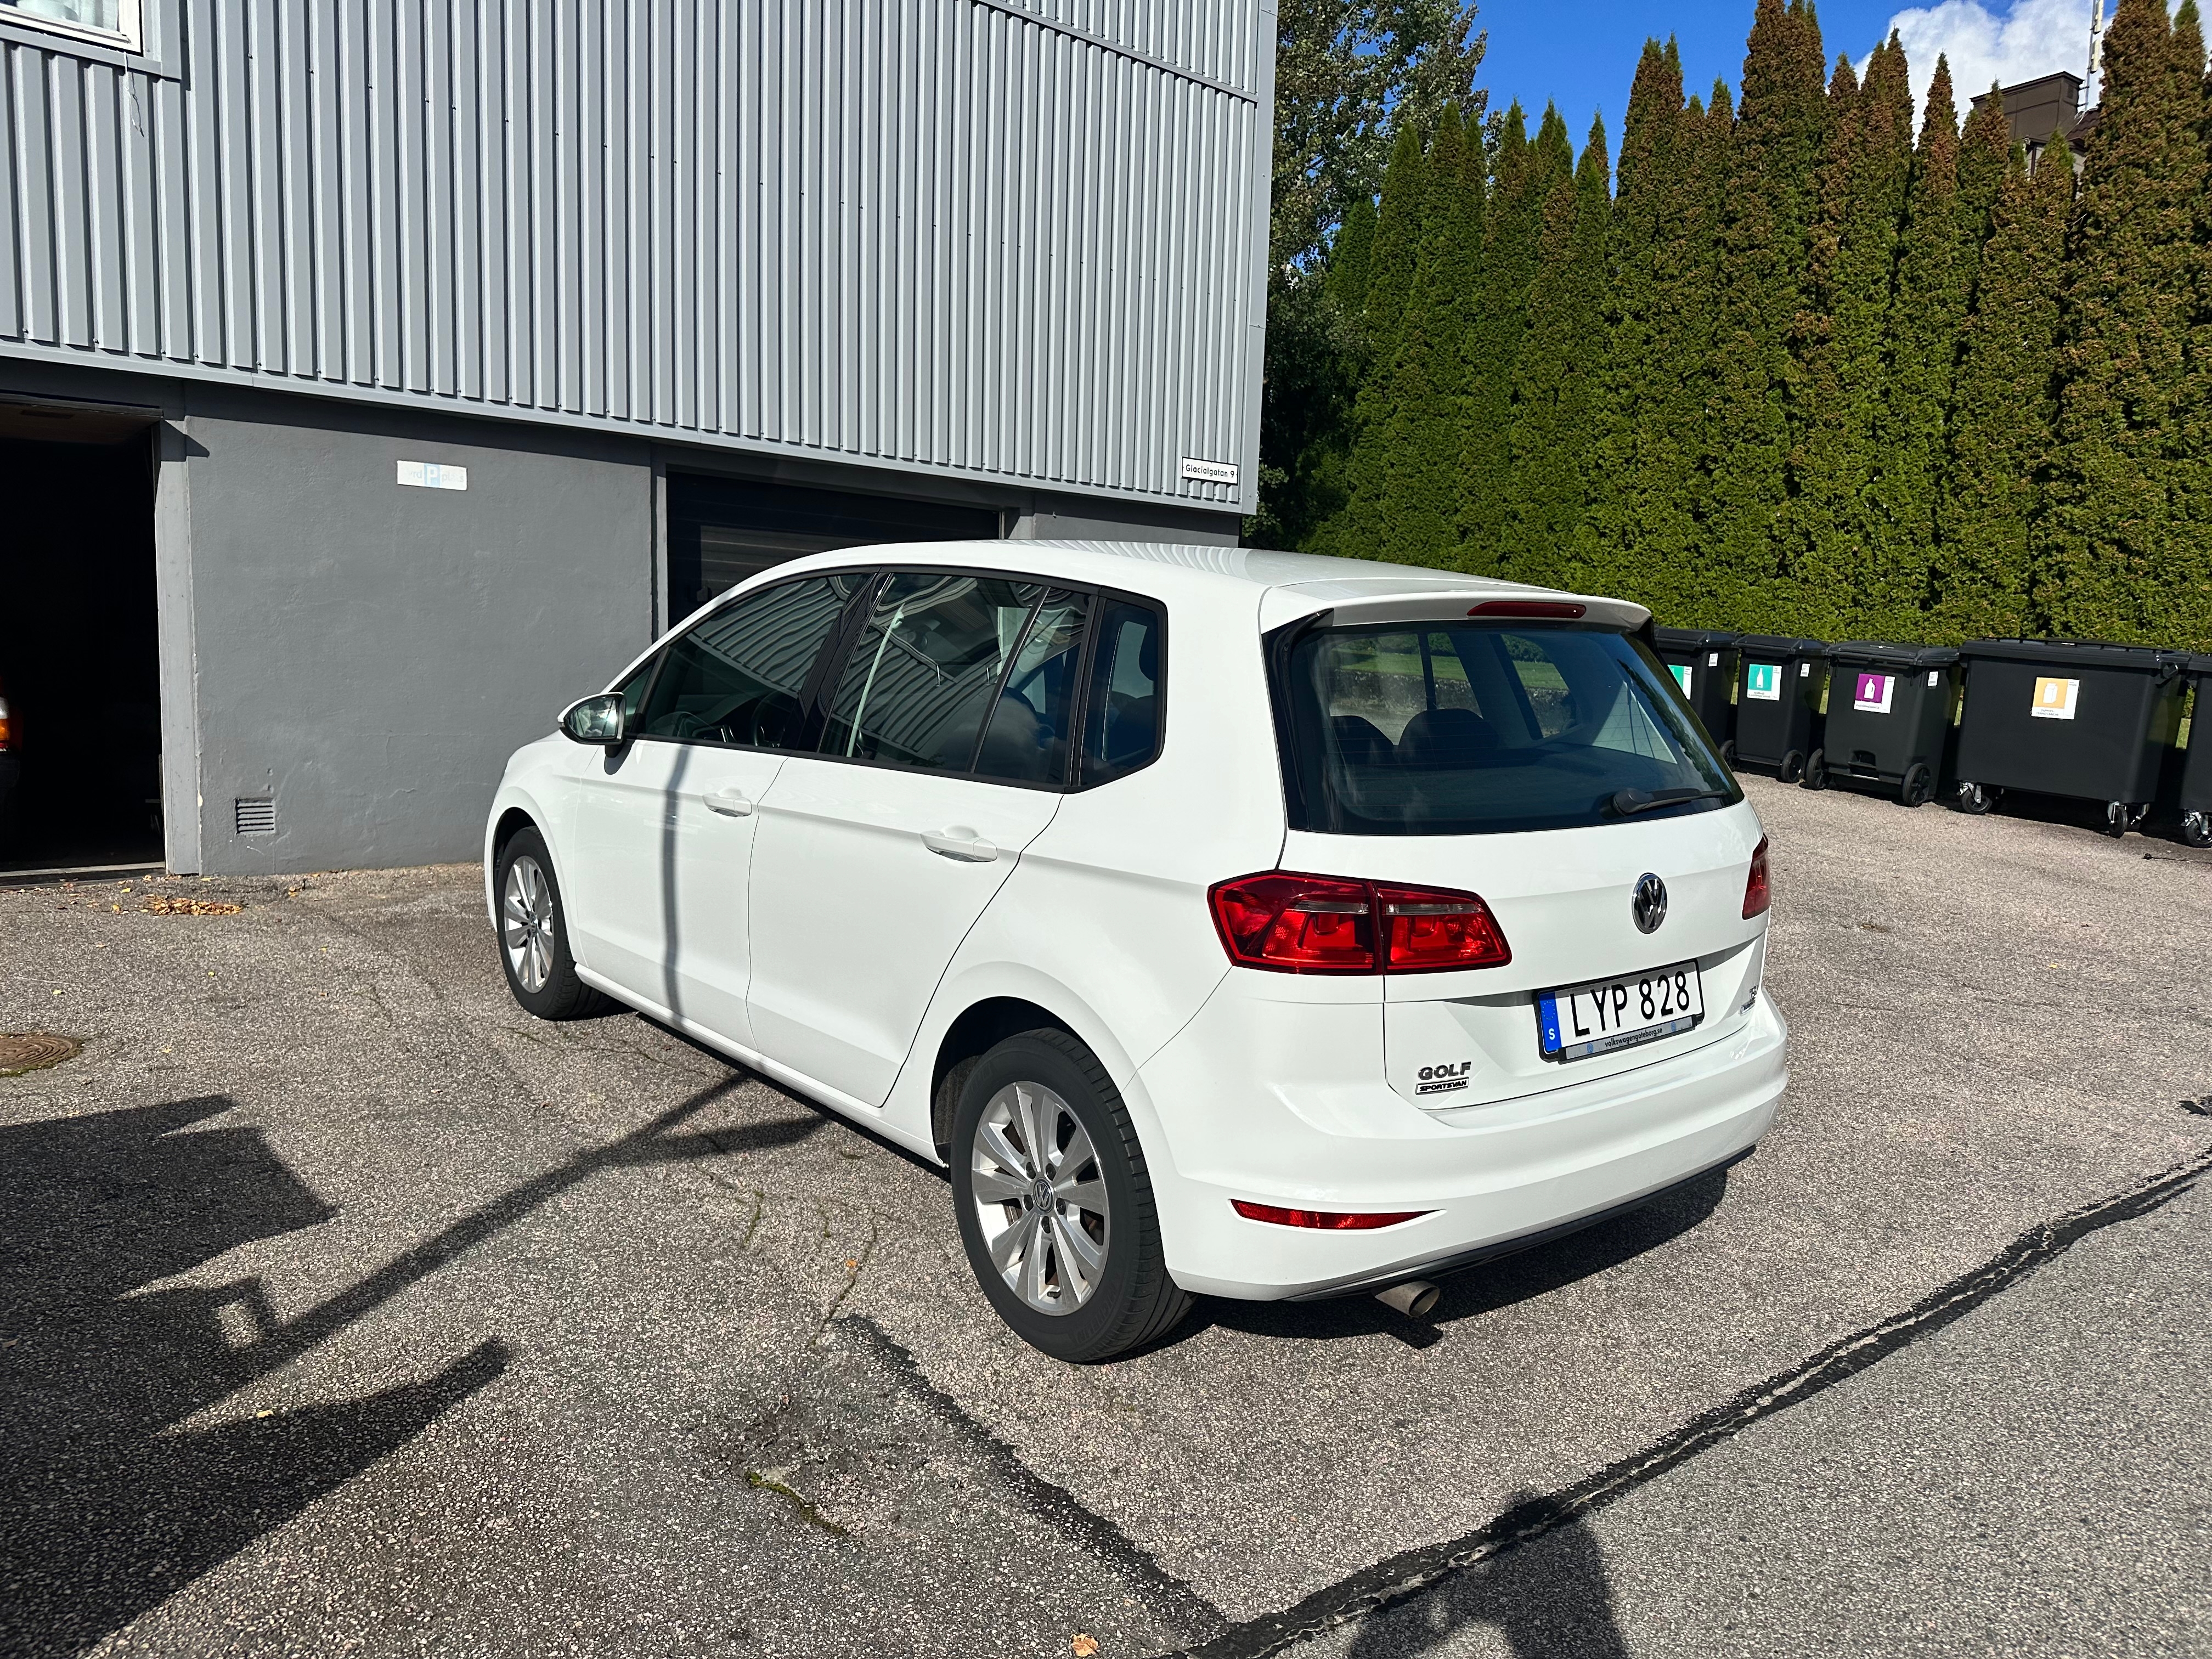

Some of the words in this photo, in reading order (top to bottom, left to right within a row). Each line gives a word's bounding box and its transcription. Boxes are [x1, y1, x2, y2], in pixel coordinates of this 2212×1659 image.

[1186, 464, 1228, 477] Glacialgatan
[1548, 1028, 1556, 1041] S
[1570, 983, 1628, 1038] LYP
[1638, 970, 1690, 1020] 828
[1418, 1061, 1472, 1080] GOLF
[1419, 1080, 1468, 1092] SPORTSVAN
